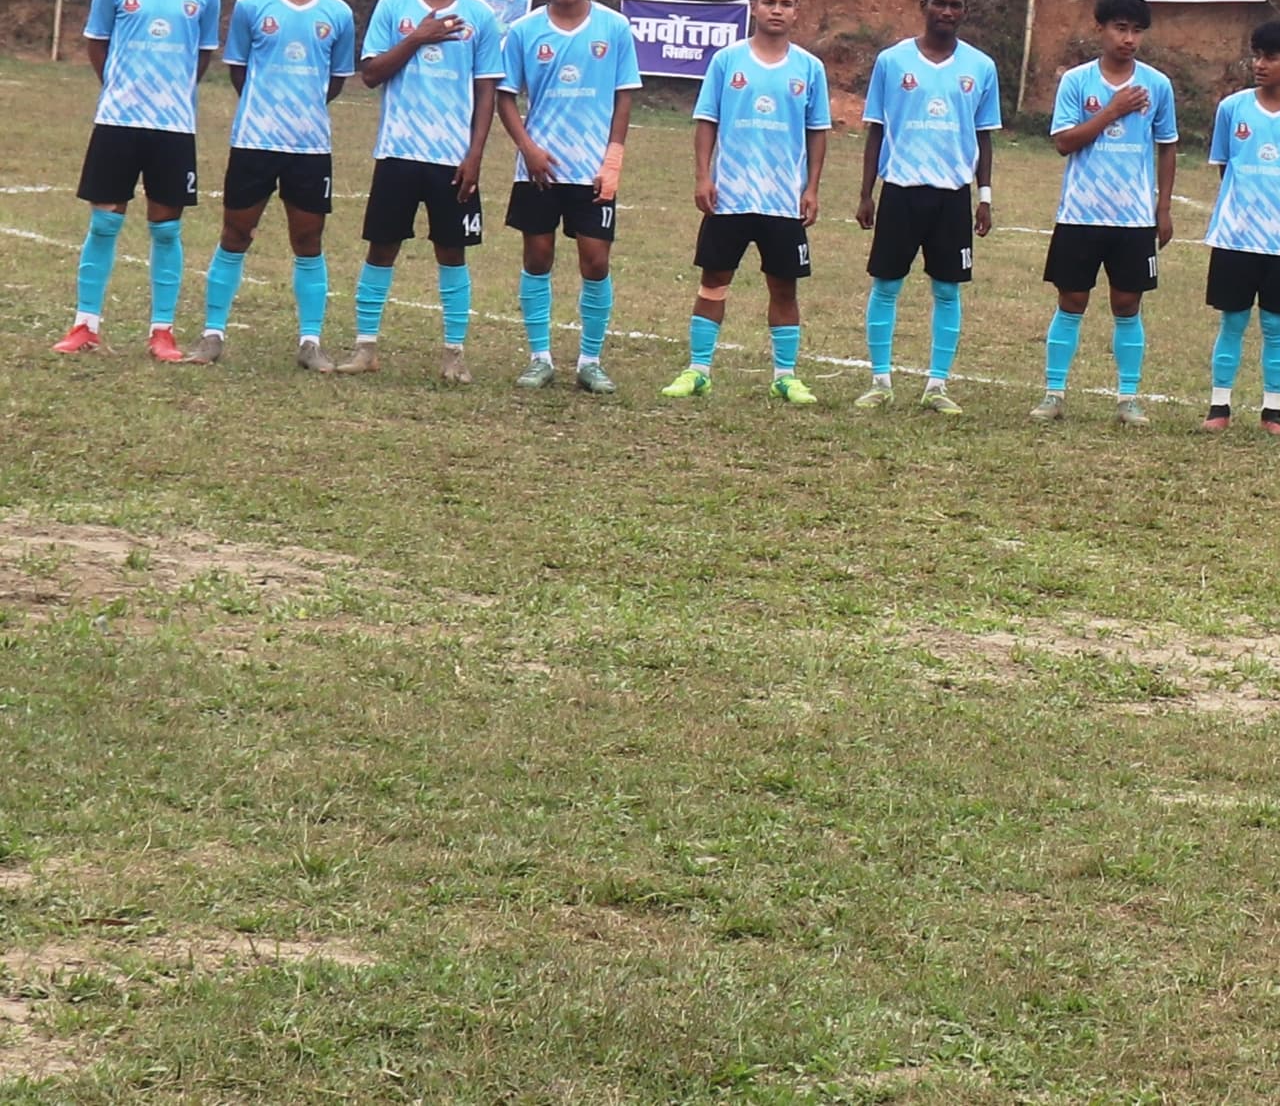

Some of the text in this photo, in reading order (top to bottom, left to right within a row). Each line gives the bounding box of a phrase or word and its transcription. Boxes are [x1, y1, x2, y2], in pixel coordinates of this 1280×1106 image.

[187, 172, 196, 193] 2
[324, 177, 331, 198] 7
[463, 213, 481, 236] 14
[602, 206, 613, 229] 17
[798, 244, 809, 266] 12
